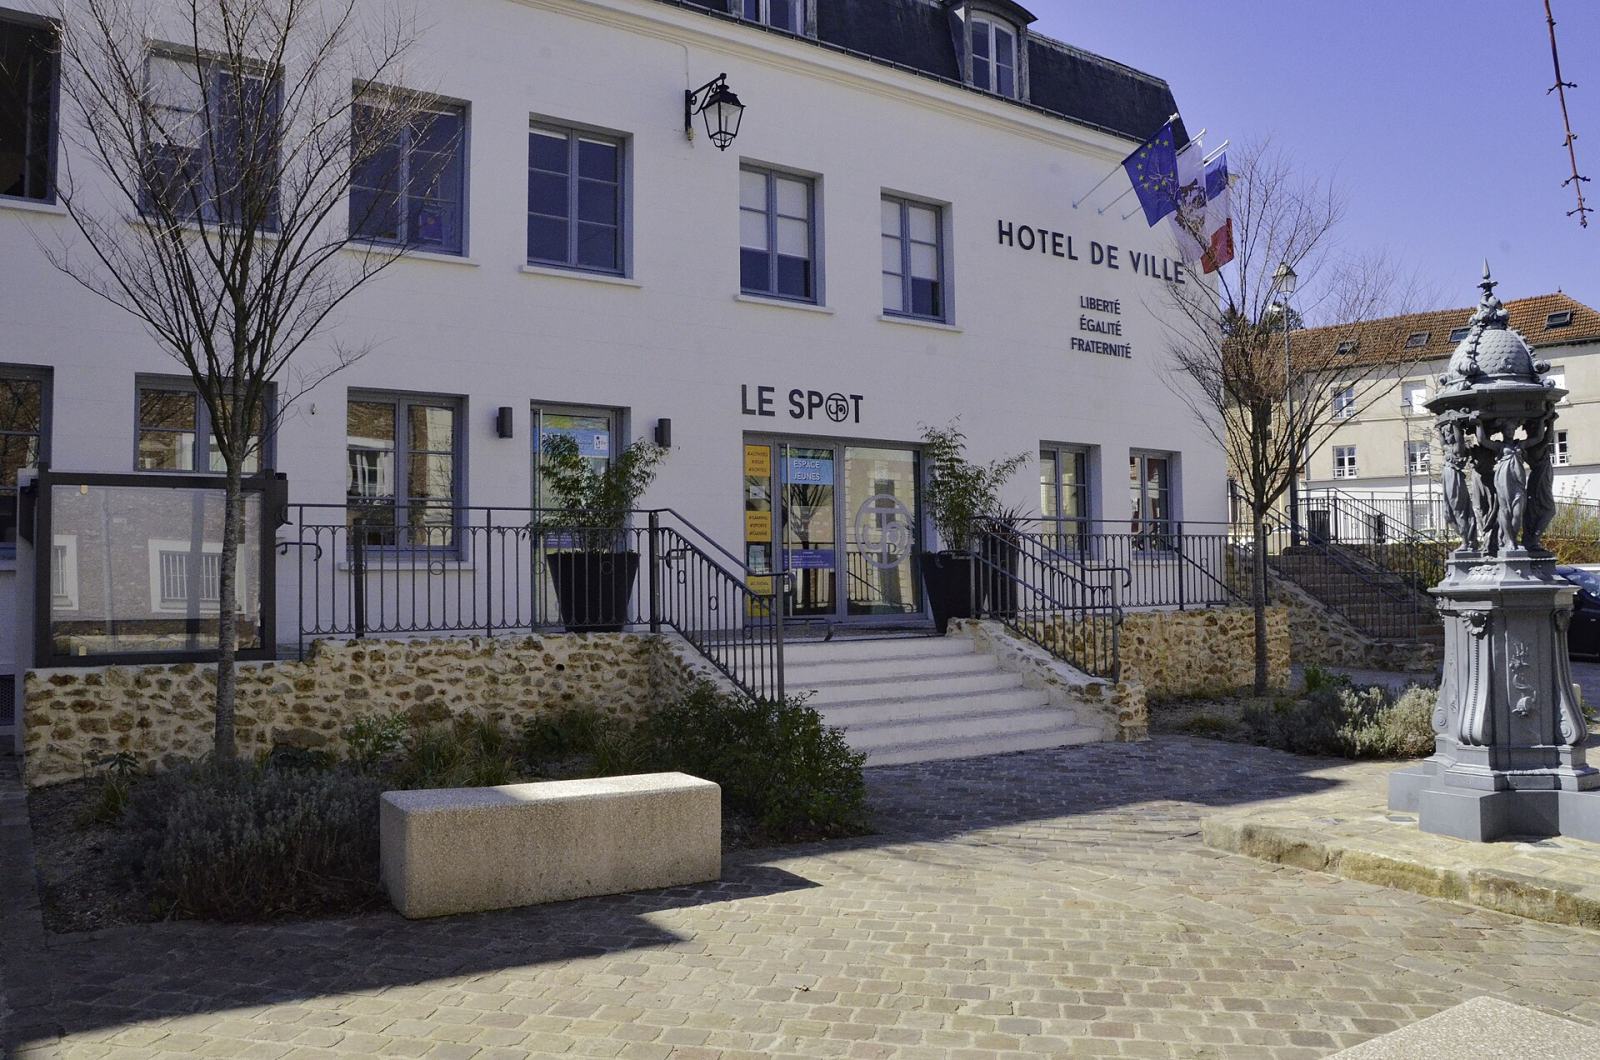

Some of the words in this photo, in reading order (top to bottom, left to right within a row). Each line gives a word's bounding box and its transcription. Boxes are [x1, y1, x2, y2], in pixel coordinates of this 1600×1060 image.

[998, 219, 1078, 261] HOTEL
[1091, 241, 1119, 270] DE
[1129, 250, 1186, 285] VILLE
[1080, 295, 1121, 315] LIBERTÉ
[1079, 314, 1122, 337] ÉGALITÉ
[1071, 337, 1132, 359] FRATERNITÉ
[741, 384, 776, 417] LE
[788, 389, 864, 423] SPOT
[793, 459, 821, 469] ESPACE
[793, 471, 821, 482] JEUNES
